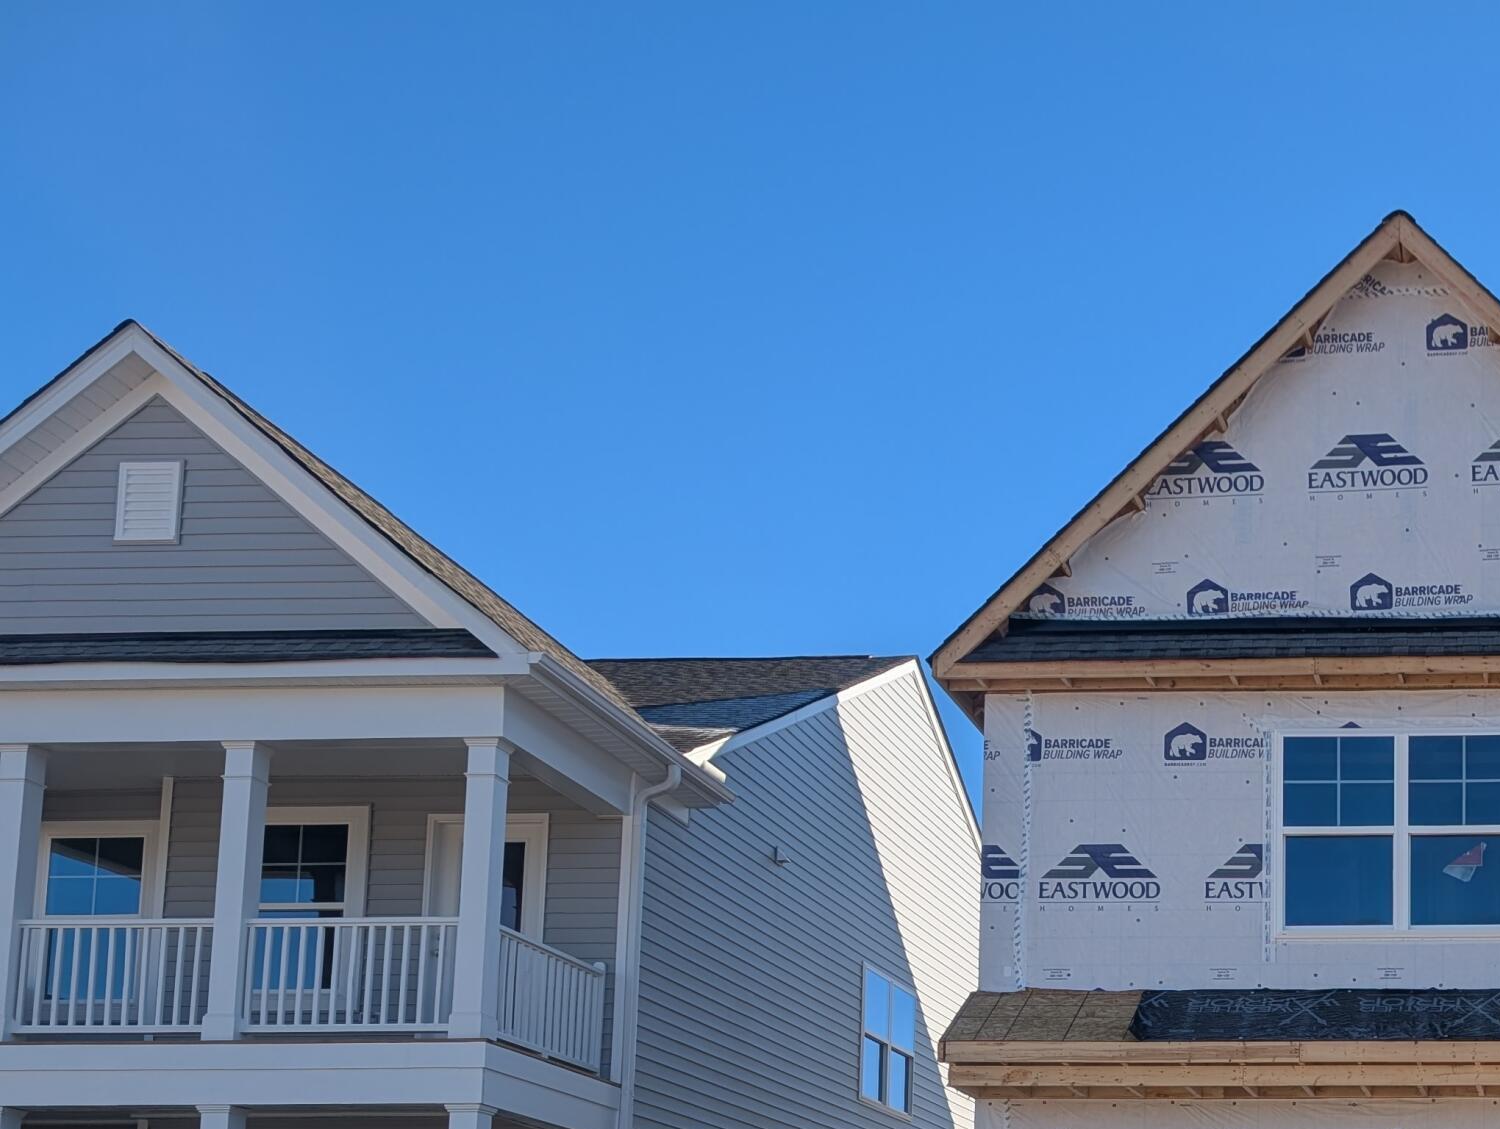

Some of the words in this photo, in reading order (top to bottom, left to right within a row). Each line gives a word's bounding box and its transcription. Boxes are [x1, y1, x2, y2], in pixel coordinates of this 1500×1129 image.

[1356, 342, 1385, 352] WRAP
[1308, 467, 1428, 489] EASTWOOD
[1146, 475, 1264, 496] EASTWOOD
[1230, 591, 1297, 602] BARRICADE
[1395, 585, 1462, 597] BARRICADE
[1067, 596, 1134, 607] BARRICADE
[1230, 601, 1278, 612] BUILDING
[1280, 600, 1309, 610] WRAP
[1395, 597, 1442, 607] BUILDING
[1444, 594, 1474, 605] WRAP
[1067, 606, 1115, 616] BUILDING
[1115, 606, 1146, 616] WRAP
[1044, 738, 1111, 749] BARRICADE
[1209, 737, 1265, 748] BARRICA
[1043, 749, 1091, 760] BUILDING
[1093, 749, 1123, 760] WRAP
[1207, 748, 1255, 759] BUILDING
[1038, 881, 1161, 899] EASTWOOD
